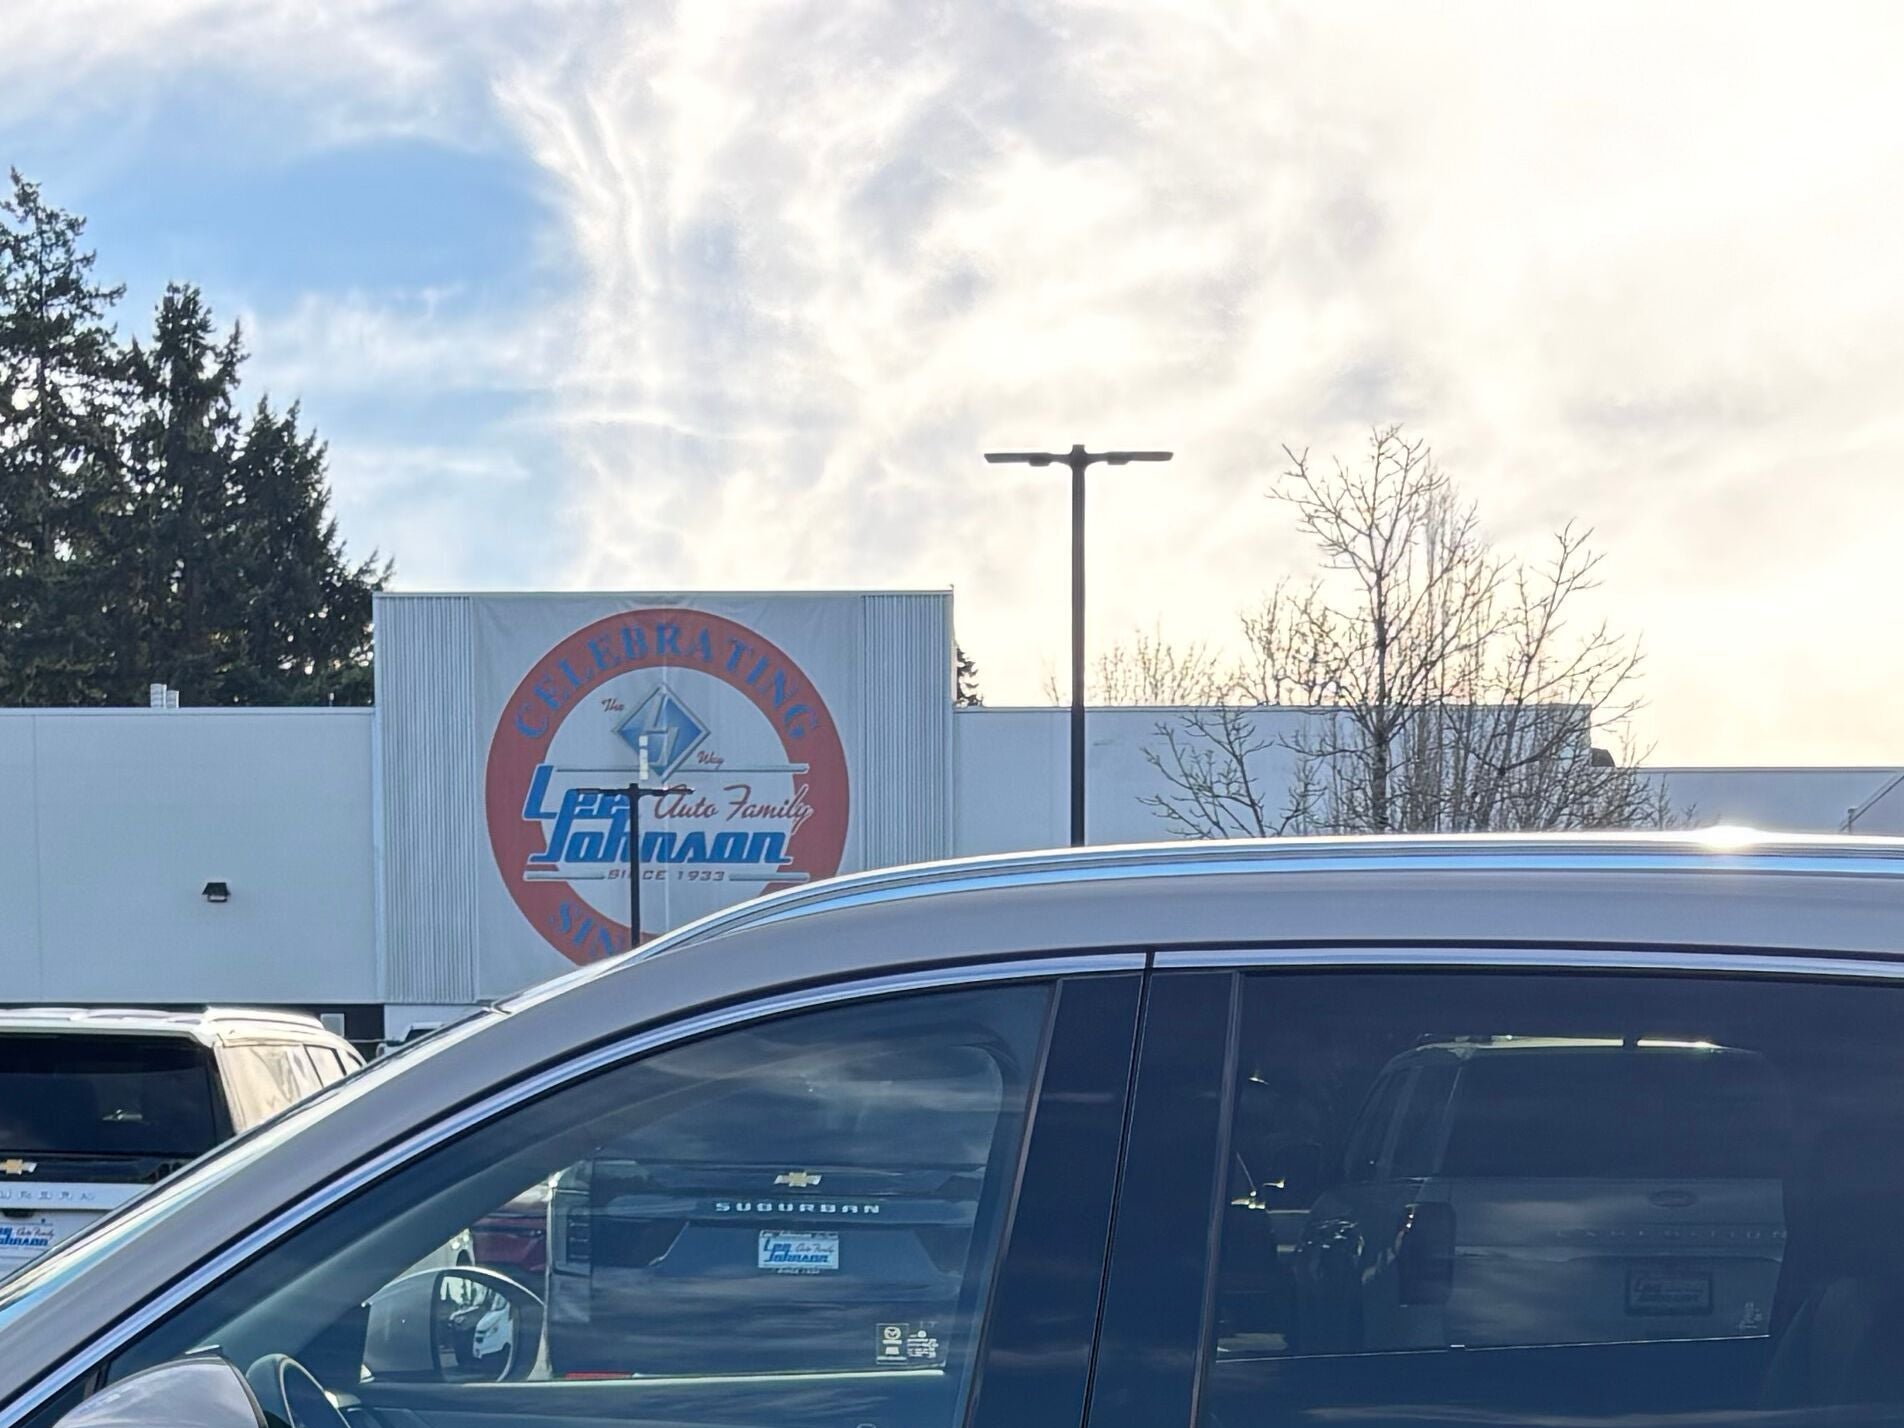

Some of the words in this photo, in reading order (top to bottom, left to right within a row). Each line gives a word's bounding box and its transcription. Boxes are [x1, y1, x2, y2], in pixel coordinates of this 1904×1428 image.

[514, 622, 818, 739] CELEBRATING
[600, 696, 626, 713] The
[523, 763, 633, 820] Lee
[653, 783, 719, 821] Auto
[722, 783, 814, 836] Family
[528, 803, 795, 864] Johnson
[607, 868, 668, 881] SICE
[677, 868, 726, 882] 1933
[715, 1202, 880, 1214] SUBURBAN
